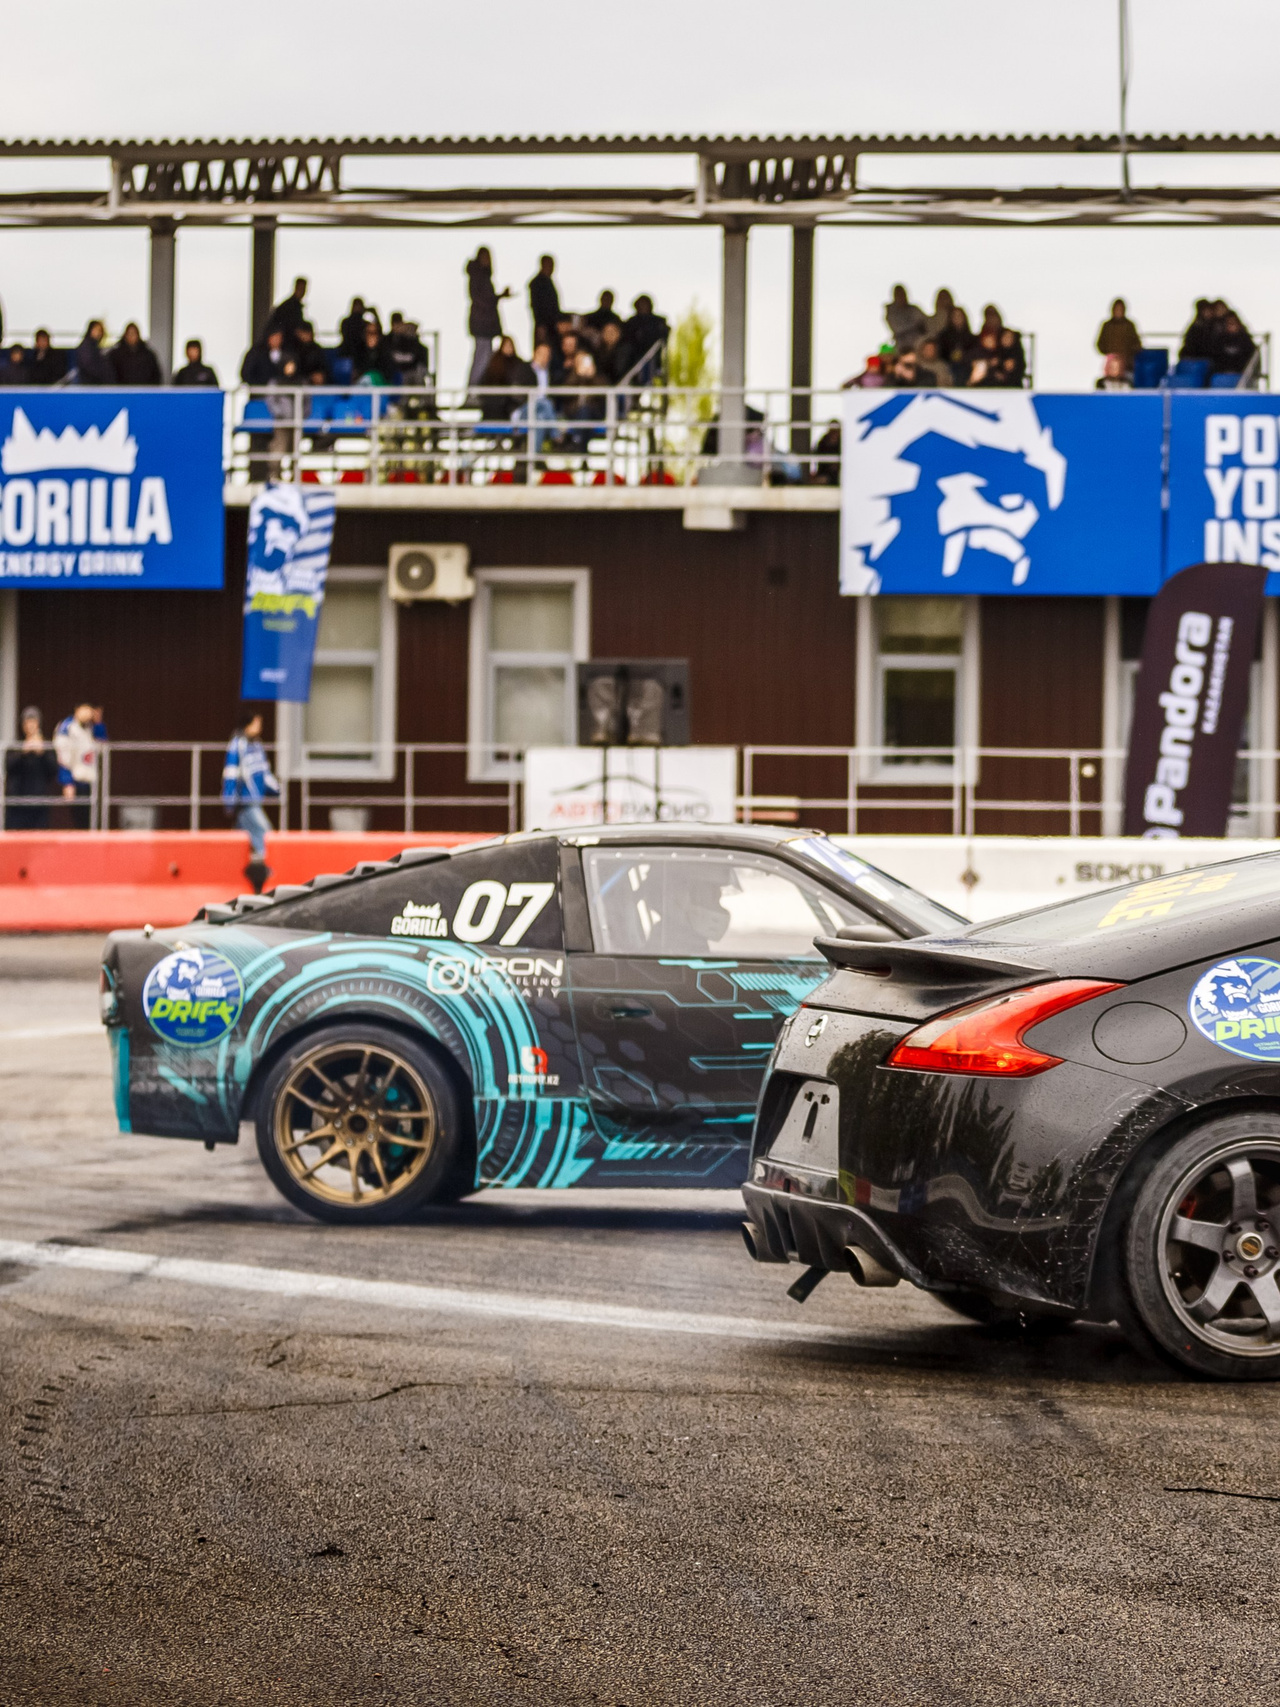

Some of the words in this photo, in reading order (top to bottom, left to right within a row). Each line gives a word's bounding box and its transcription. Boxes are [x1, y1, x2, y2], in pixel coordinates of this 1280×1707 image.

[0, 476, 173, 547] ORILLA
[78, 549, 144, 577] DRINK
[1144, 611, 1212, 827] Pandora
[390, 915, 448, 937] GORILLA
[452, 879, 555, 946] 07
[473, 957, 563, 977] IRON
[151, 997, 235, 1026] DRIFT
